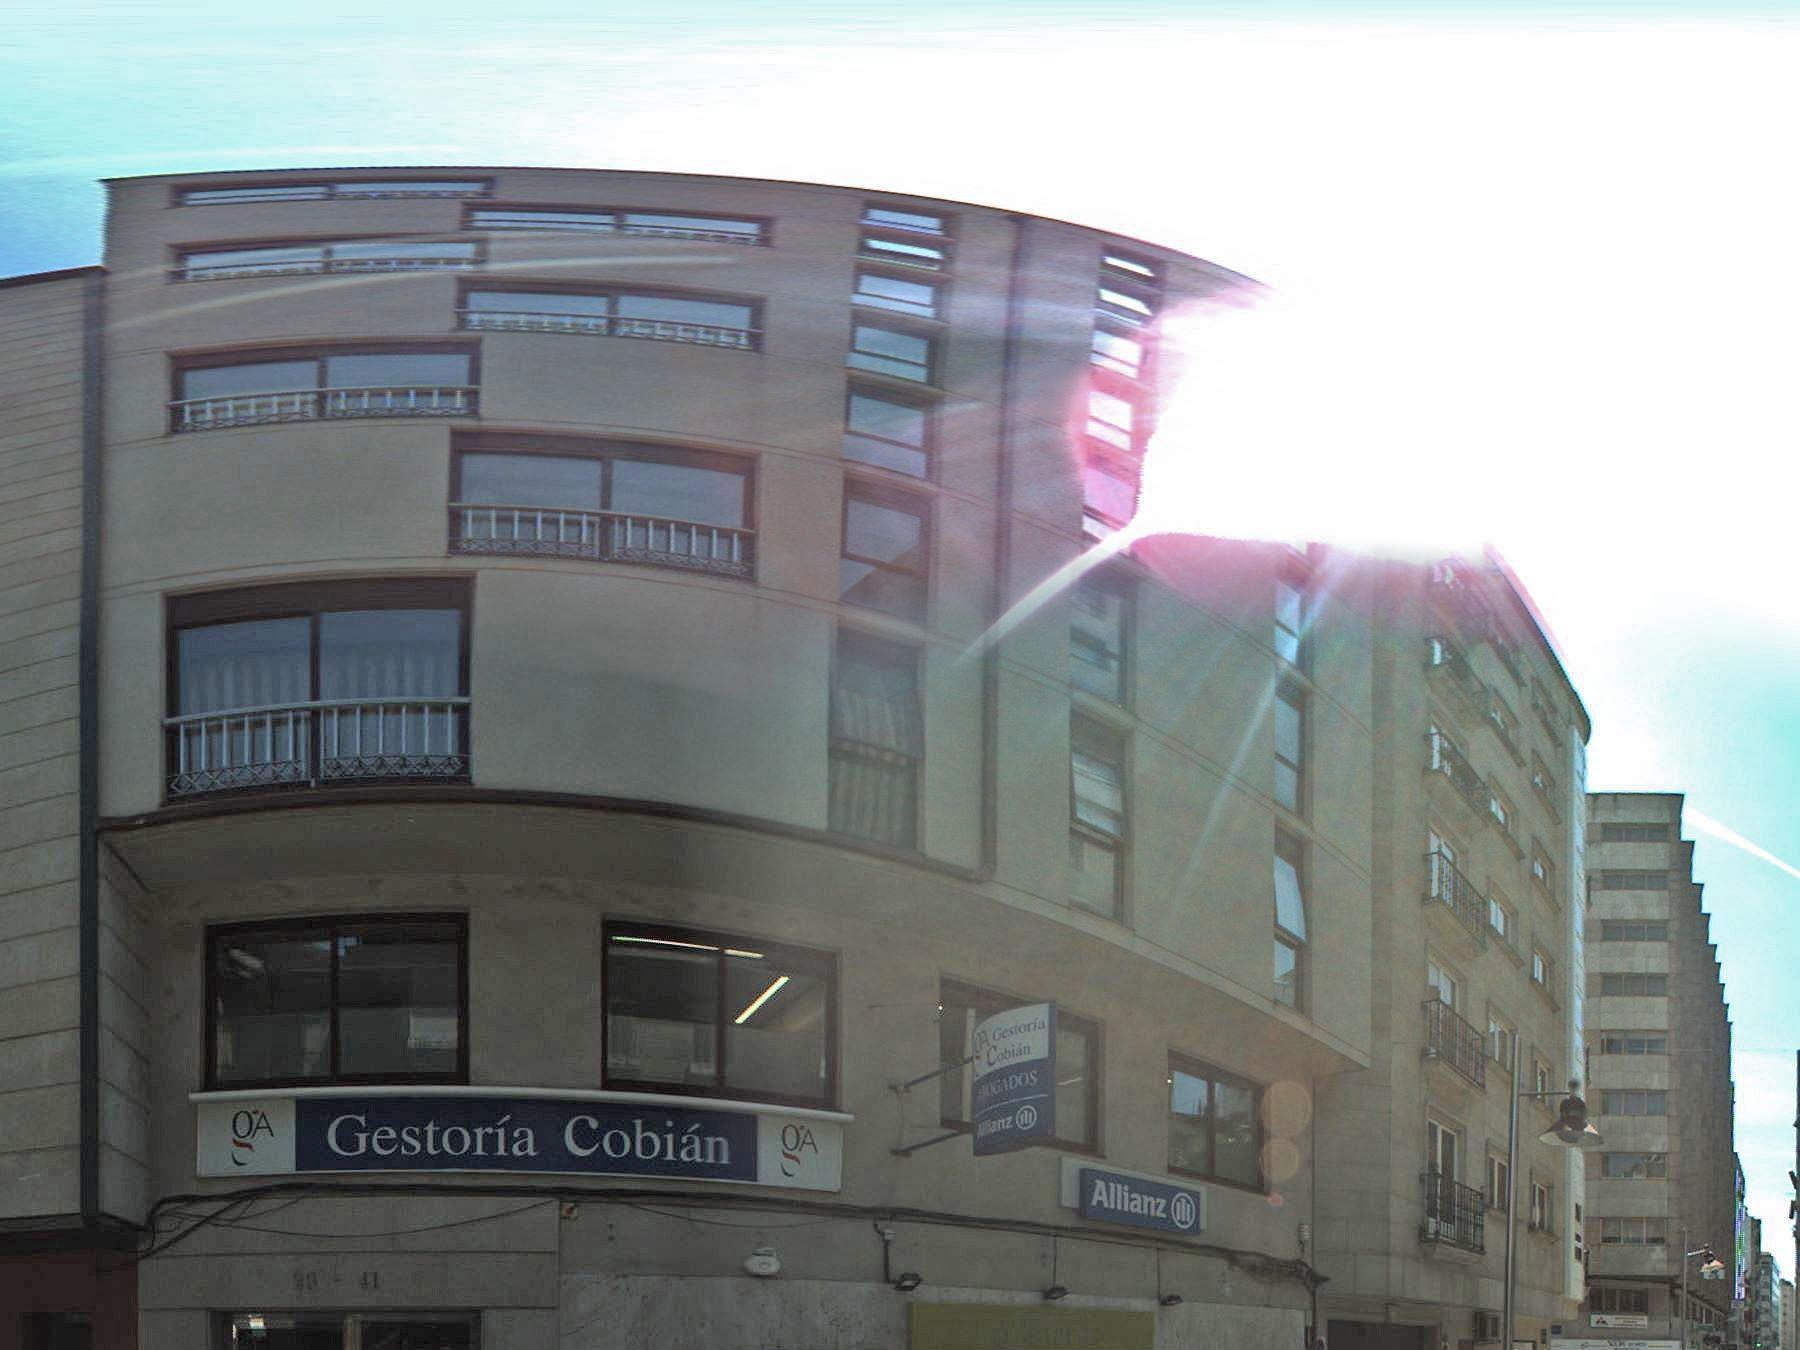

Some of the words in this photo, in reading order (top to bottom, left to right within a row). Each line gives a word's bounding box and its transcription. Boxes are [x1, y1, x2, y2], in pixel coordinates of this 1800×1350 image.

[327, 1112, 537, 1158] Gestoría
[563, 1113, 731, 1165] Cobián
[1091, 1178, 1168, 1219] Allianz
